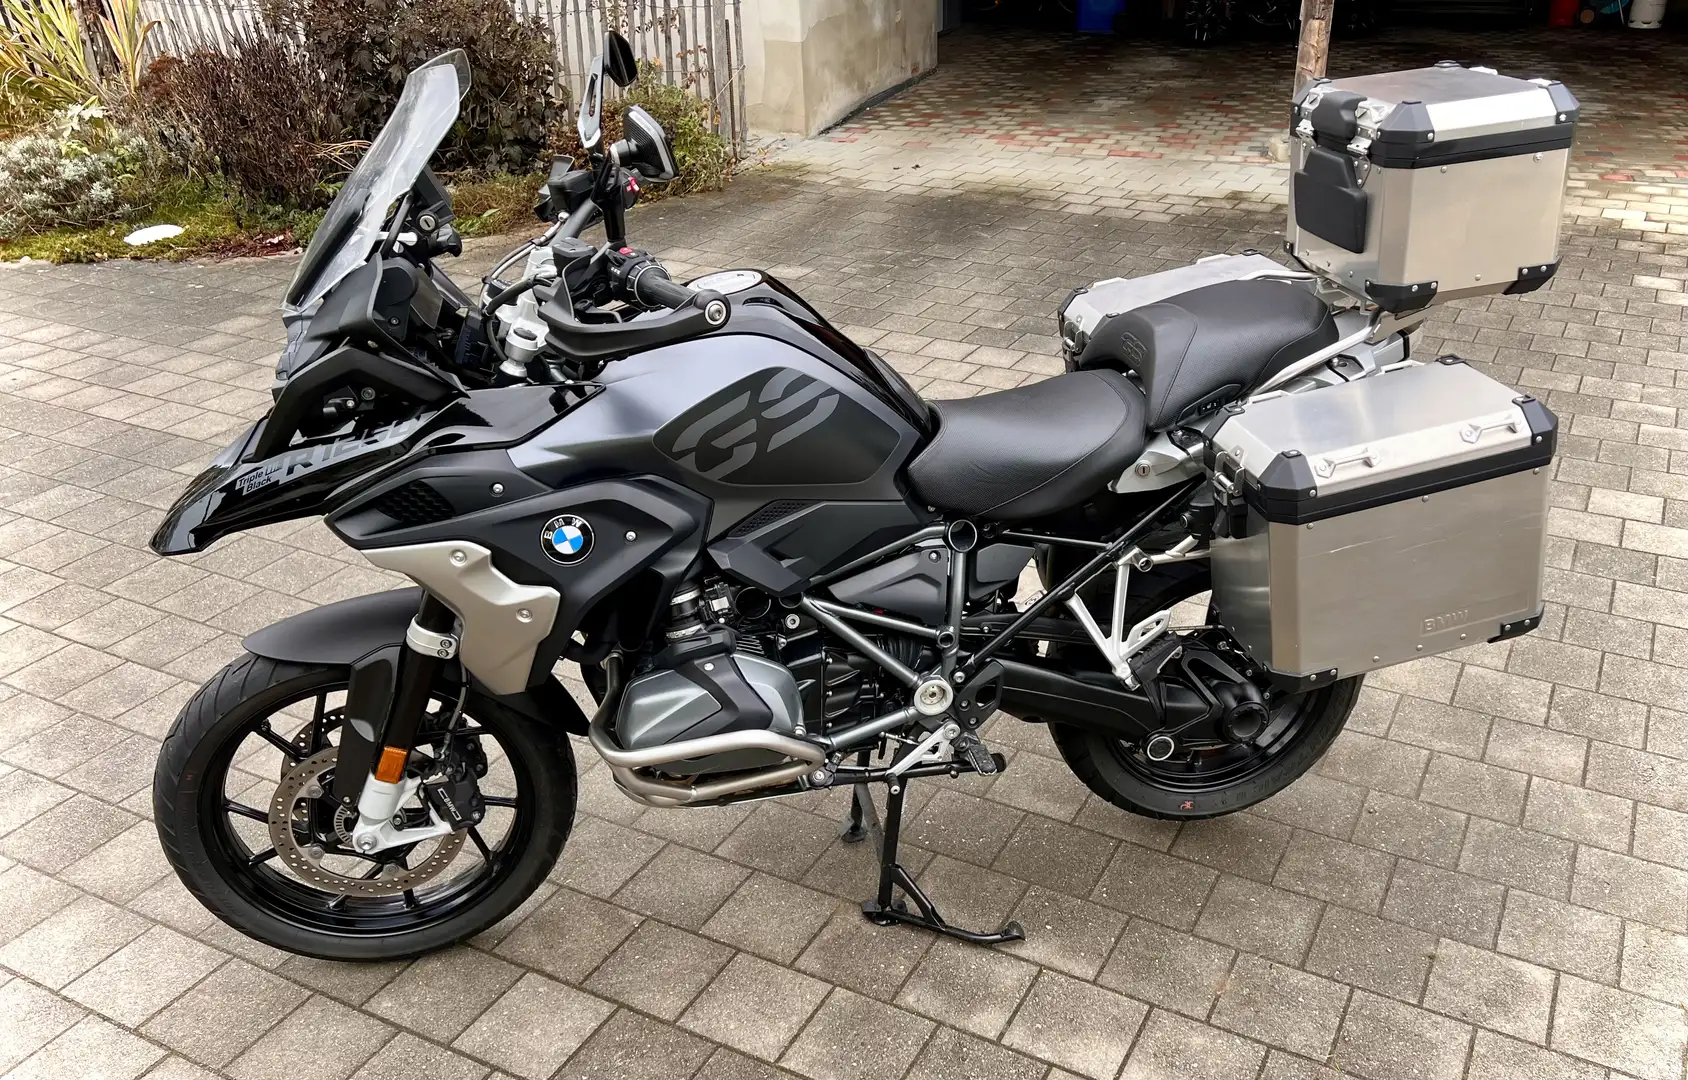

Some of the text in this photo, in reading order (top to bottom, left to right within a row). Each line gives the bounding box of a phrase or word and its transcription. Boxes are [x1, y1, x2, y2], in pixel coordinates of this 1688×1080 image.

[672, 367, 840, 480] GS
[239, 471, 264, 487] Triple
[247, 475, 272, 492] Black
[543, 517, 584, 540] BMW
[1424, 609, 1469, 632] BMW
[443, 797, 457, 812] BMW
